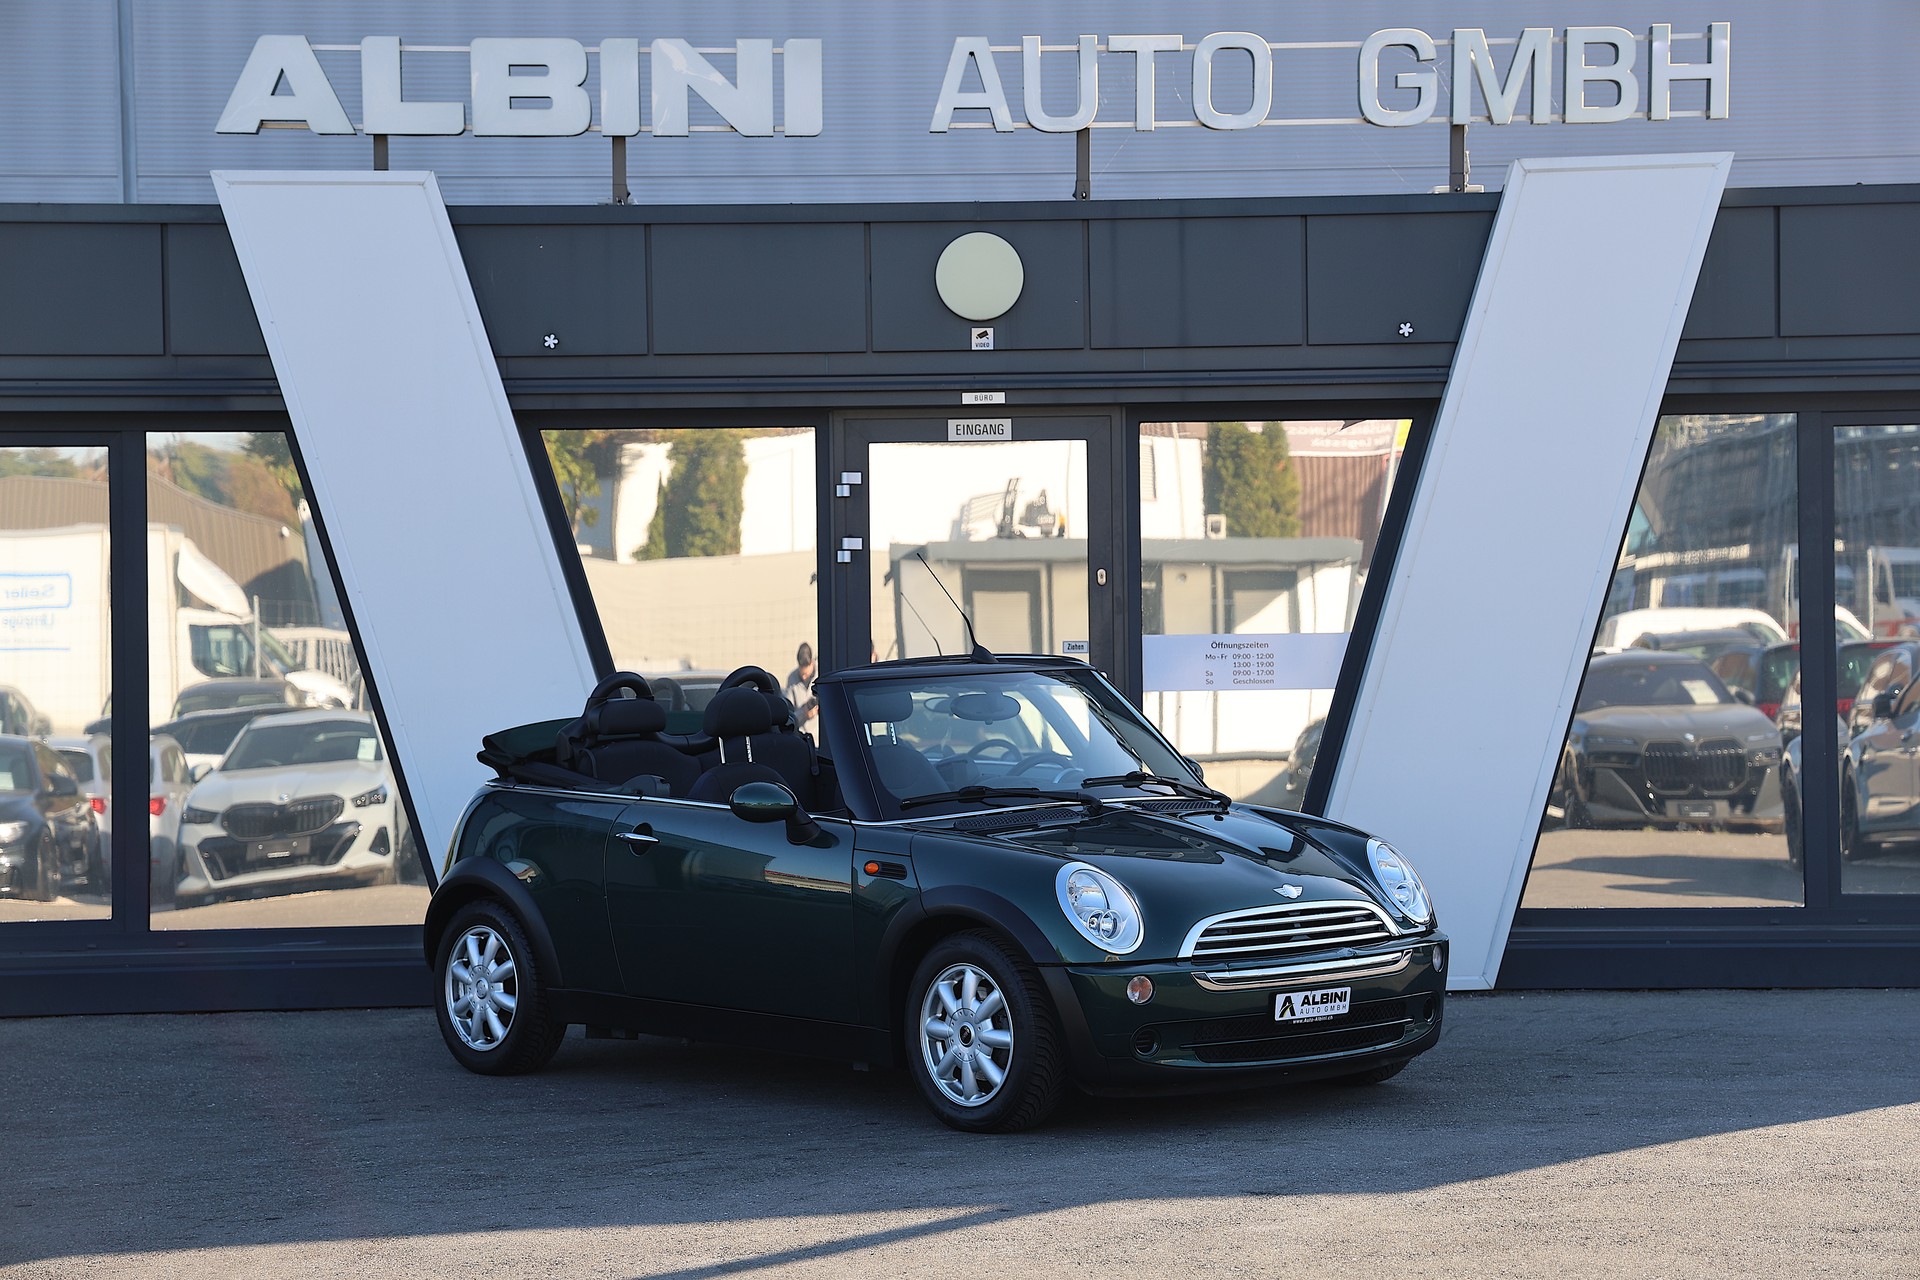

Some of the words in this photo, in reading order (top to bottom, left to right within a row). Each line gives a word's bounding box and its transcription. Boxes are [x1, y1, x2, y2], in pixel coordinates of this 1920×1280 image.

[214, 34, 824, 138] ALBINI
[929, 31, 1273, 134] AUTO
[1358, 21, 1732, 128] GMBH
[955, 423, 1005, 436] EINGANG
[1210, 640, 1269, 650] Öffnungszeiten
[1300, 991, 1348, 1007] ALBINI
[1299, 1006, 1321, 1015] AUTO
[1324, 1003, 1347, 1013] GMBH
